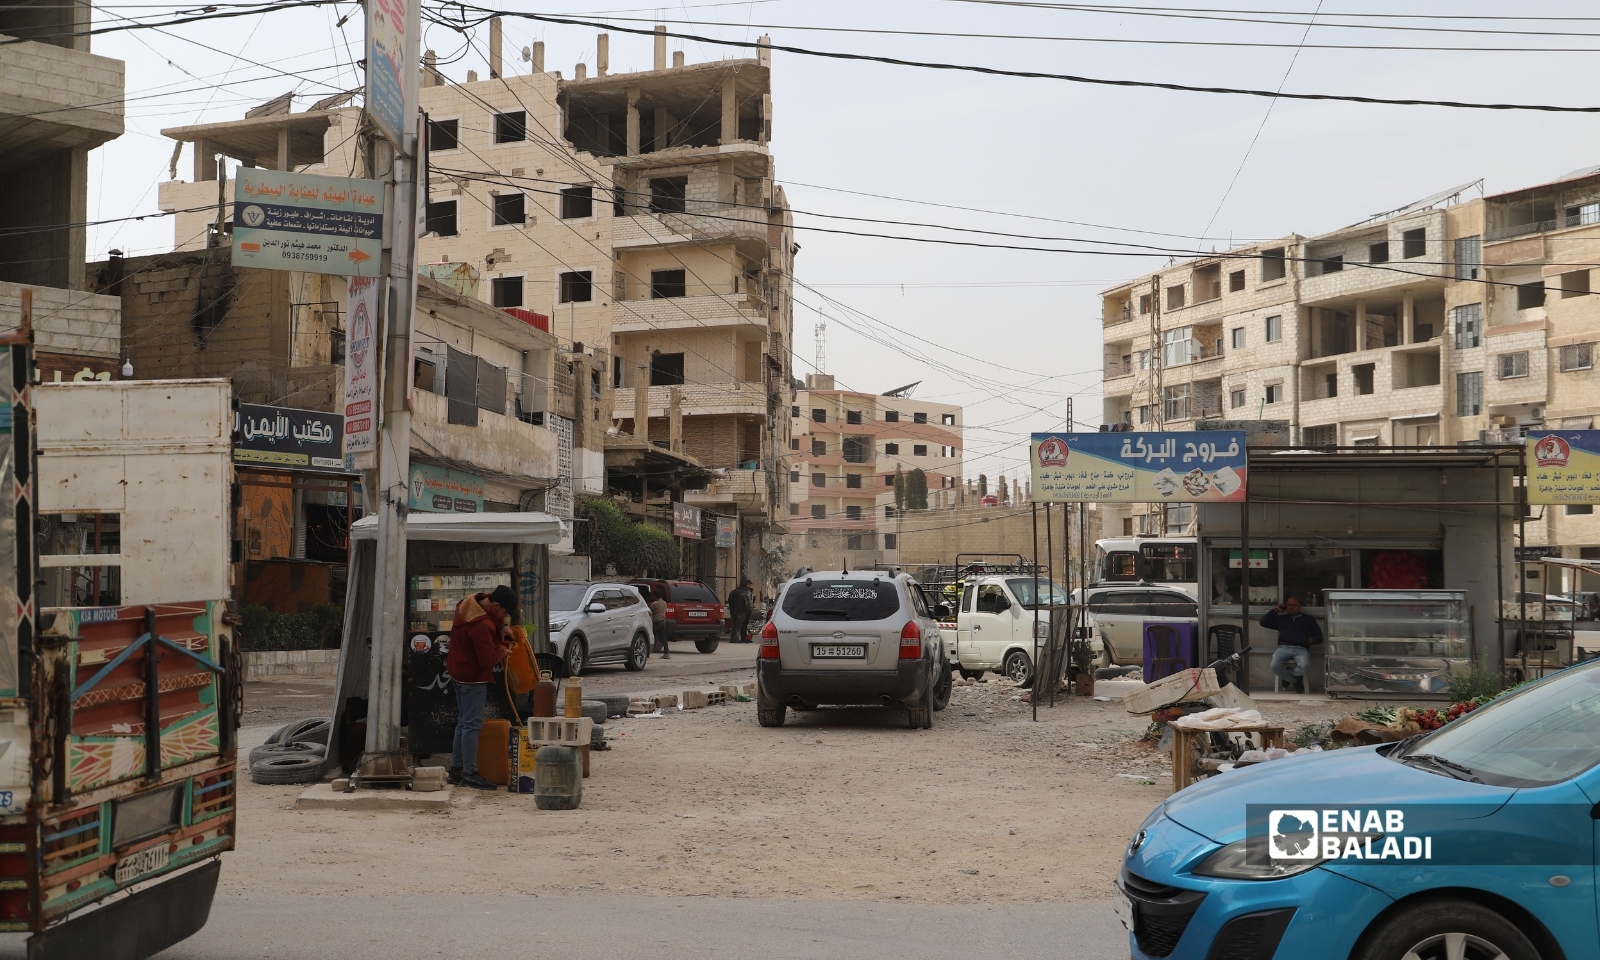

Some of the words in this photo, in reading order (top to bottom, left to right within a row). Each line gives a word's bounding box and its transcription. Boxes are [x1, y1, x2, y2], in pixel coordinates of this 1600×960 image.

[244, 178, 286, 198] البيطرية
[289, 183, 319, 202] للعناية
[322, 185, 350, 204] الهيثم
[353, 190, 376, 207] عيادة
[262, 238, 279, 248] الدين
[280, 239, 290, 249] نور
[291, 239, 305, 250] هيثم
[326, 243, 348, 252] الدكتور
[281, 251, 328, 262] 0938759919
[244, 410, 289, 444] الأيمن
[293, 420, 333, 446] مكتب
[1120, 436, 1176, 463] البركة
[1182, 437, 1240, 463] فروج
[80, 610, 91, 622] KIA
[94, 608, 118, 621] MOTORS
[816, 647, 827, 656] 15
[836, 647, 862, 656] 51260
[511, 737, 519, 785] MORRIS
